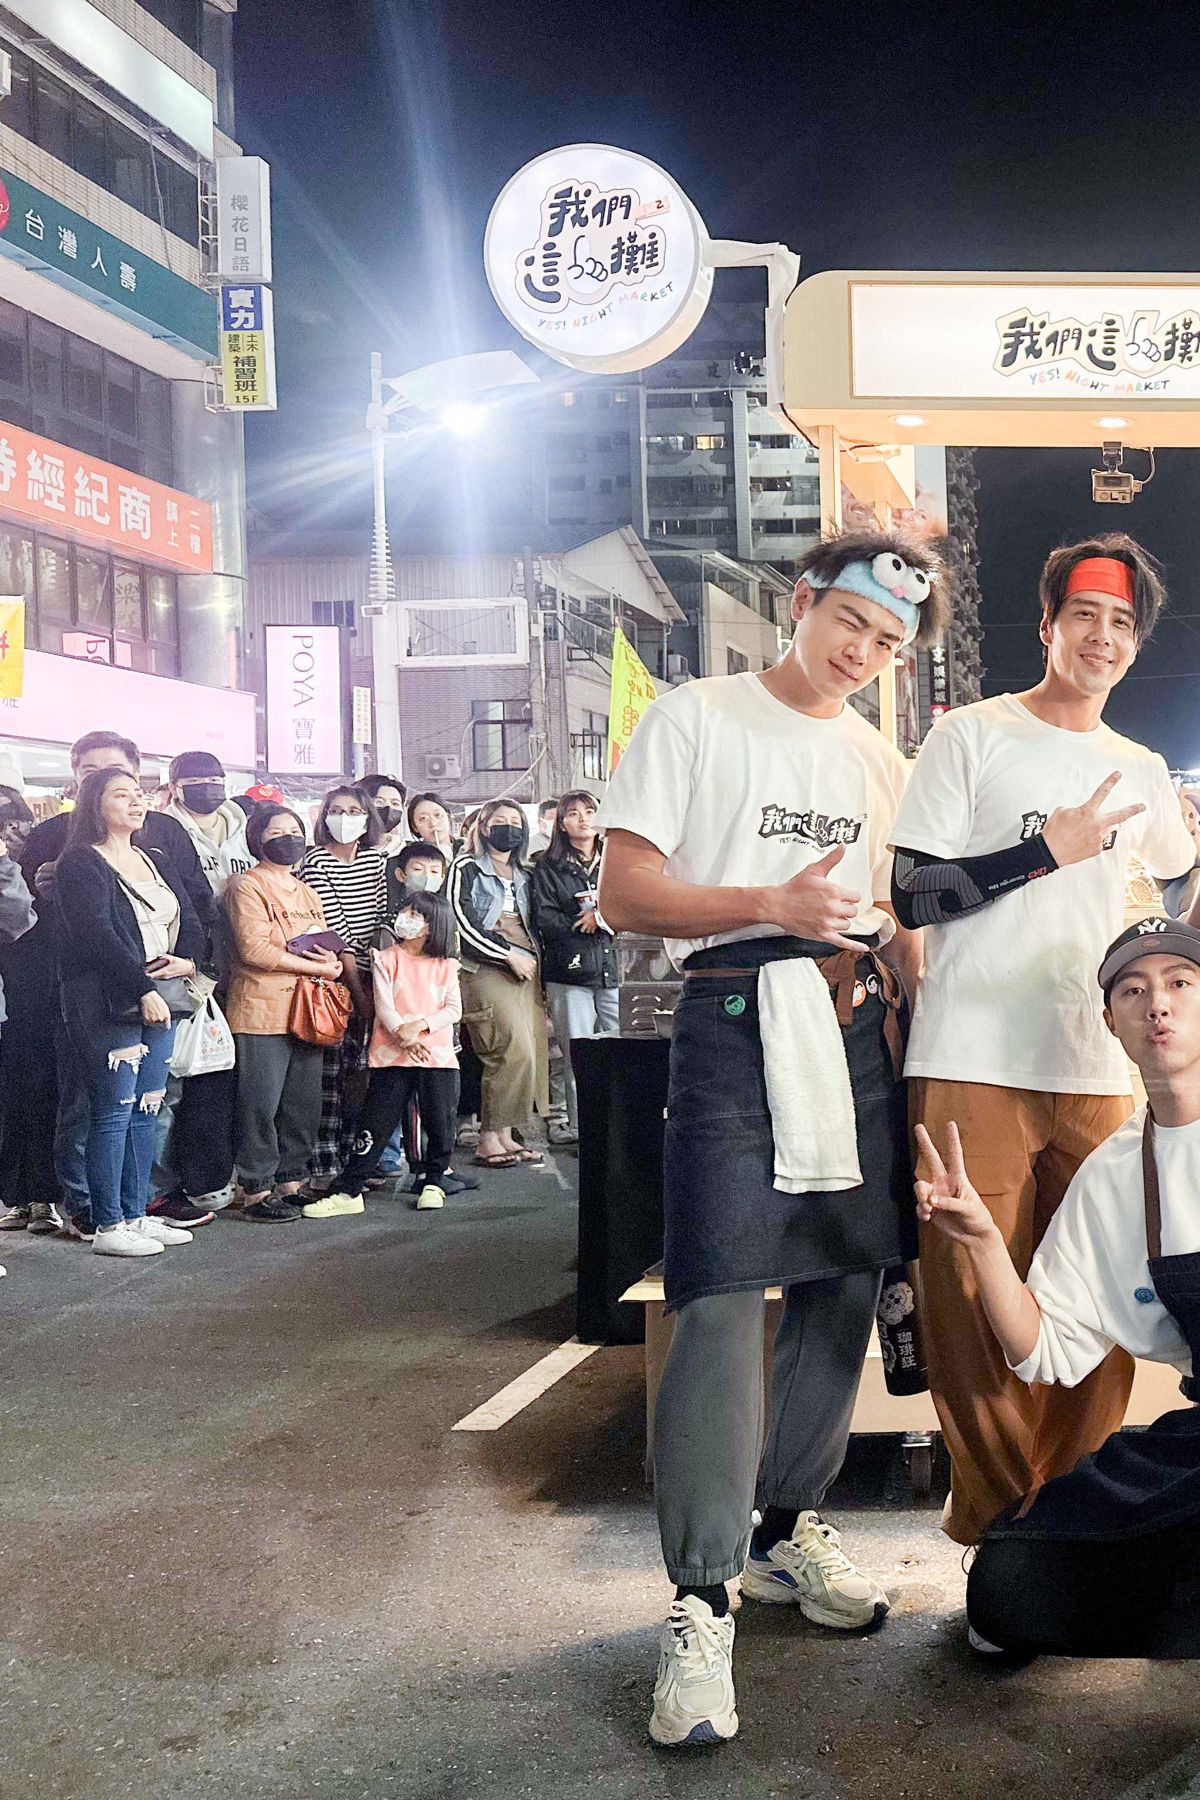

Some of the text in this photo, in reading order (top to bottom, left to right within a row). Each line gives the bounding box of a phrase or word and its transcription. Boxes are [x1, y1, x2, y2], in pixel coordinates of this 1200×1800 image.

[230, 194, 250, 273] 櫻花日語
[548, 186, 632, 237] 我們
[24, 208, 137, 293] 台灣人壽
[229, 288, 257, 330] 實力
[537, 281, 673, 330] YES! NIGHT MARKET
[246, 333, 259, 353] 土木
[233, 356, 258, 392] 補習班
[1030, 368, 1171, 393] YES! NIGHT MARKET
[234, 395, 258, 404] 15F
[292, 635, 315, 765] POYA 寶雅
